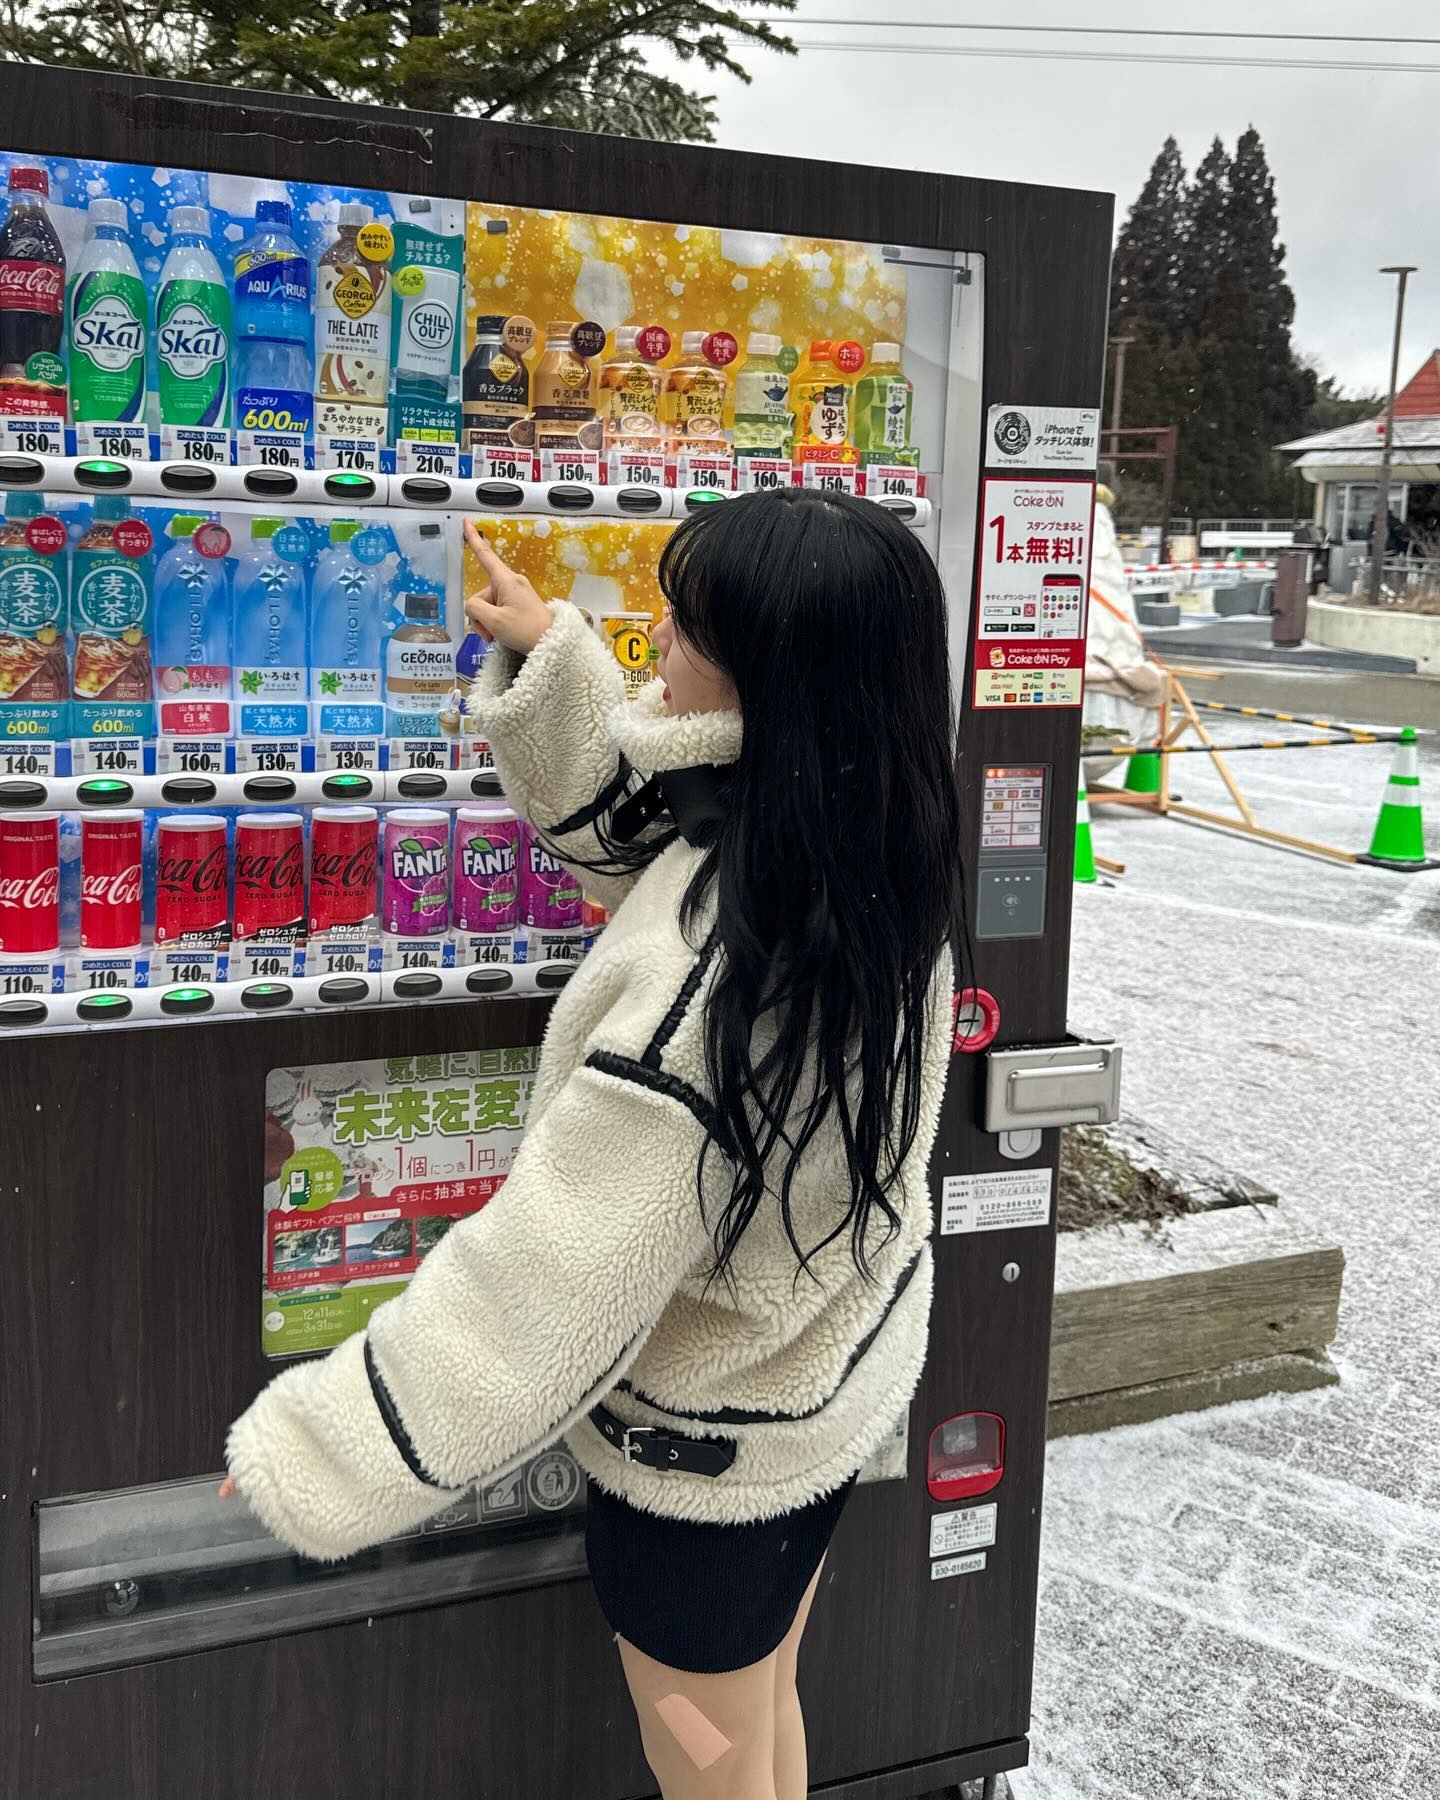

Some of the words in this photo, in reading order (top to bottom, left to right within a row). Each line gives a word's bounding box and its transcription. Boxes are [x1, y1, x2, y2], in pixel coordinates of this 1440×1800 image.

[248, 279, 307, 299] AQUARIUS
[336, 289, 376, 301] GEORGIA
[327, 320, 346, 335] THE
[349, 321, 379, 340] LATTE
[415, 313, 450, 331] CHILL
[419, 327, 445, 341] OUT
[243, 409, 308, 433] 600ml
[323, 412, 381, 426] まろやかな甘さ
[821, 408, 837, 440] ゆず
[39, 423, 59, 432] COLD
[124, 428, 144, 437] COLD
[1045, 425, 1084, 435] iPhoneで
[15, 433, 59, 453] 180円
[206, 433, 226, 442] COLD
[100, 439, 142, 458] 180円
[184, 443, 224, 462] 180円
[260, 448, 299, 467] 180円
[336, 452, 374, 470] 170円
[416, 456, 453, 475] 210円
[490, 461, 524, 480] 150円
[558, 463, 593, 481] 150円
[626, 466, 660, 484] 150円
[693, 471, 725, 488] 150円
[754, 471, 785, 487] 160円
[820, 477, 850, 492] 150円
[883, 480, 912, 496] 140円
[1013, 496, 1043, 507] Coke
[1026, 522, 1084, 531] スタンプたまると
[11, 571, 43, 624] 麦茶
[98, 574, 129, 624] 麦茶
[401, 649, 451, 663] GEORGIA
[628, 637, 640, 661] C
[1008, 655, 1032, 664] Coke
[1051, 655, 1070, 666] Pay
[191, 671, 214, 680] もも
[6, 722, 50, 734] 600ml
[92, 721, 134, 734] 600ml
[254, 714, 297, 728] 天然水
[333, 715, 374, 728] 天然水
[31, 745, 51, 754] COLD
[120, 742, 139, 750] COLD
[202, 743, 221, 751] COLD
[280, 743, 298, 751] COLD
[357, 742, 375, 750] COLD
[430, 743, 448, 751] COLD
[5, 756, 48, 774] 140円
[95, 752, 137, 770] 140円
[180, 754, 220, 772] 160円
[257, 753, 295, 771] 130円
[336, 751, 372, 769] 130円
[408, 751, 444, 769] 160円
[181, 932, 230, 941] ゼロシュガー
[259, 927, 306, 937] ゼロシュガー
[195, 955, 214, 963] COLD
[401, 952, 437, 968] 140円
[474, 947, 508, 962] 140円
[546, 946, 578, 961] 140円
[28, 965, 49, 973] COLD
[111, 961, 131, 969] COLD
[251, 958, 288, 975] 140円
[328, 956, 363, 972] 140円
[89, 972, 127, 989] 110円
[172, 965, 210, 982] 140円
[4, 976, 44, 993] 110円
